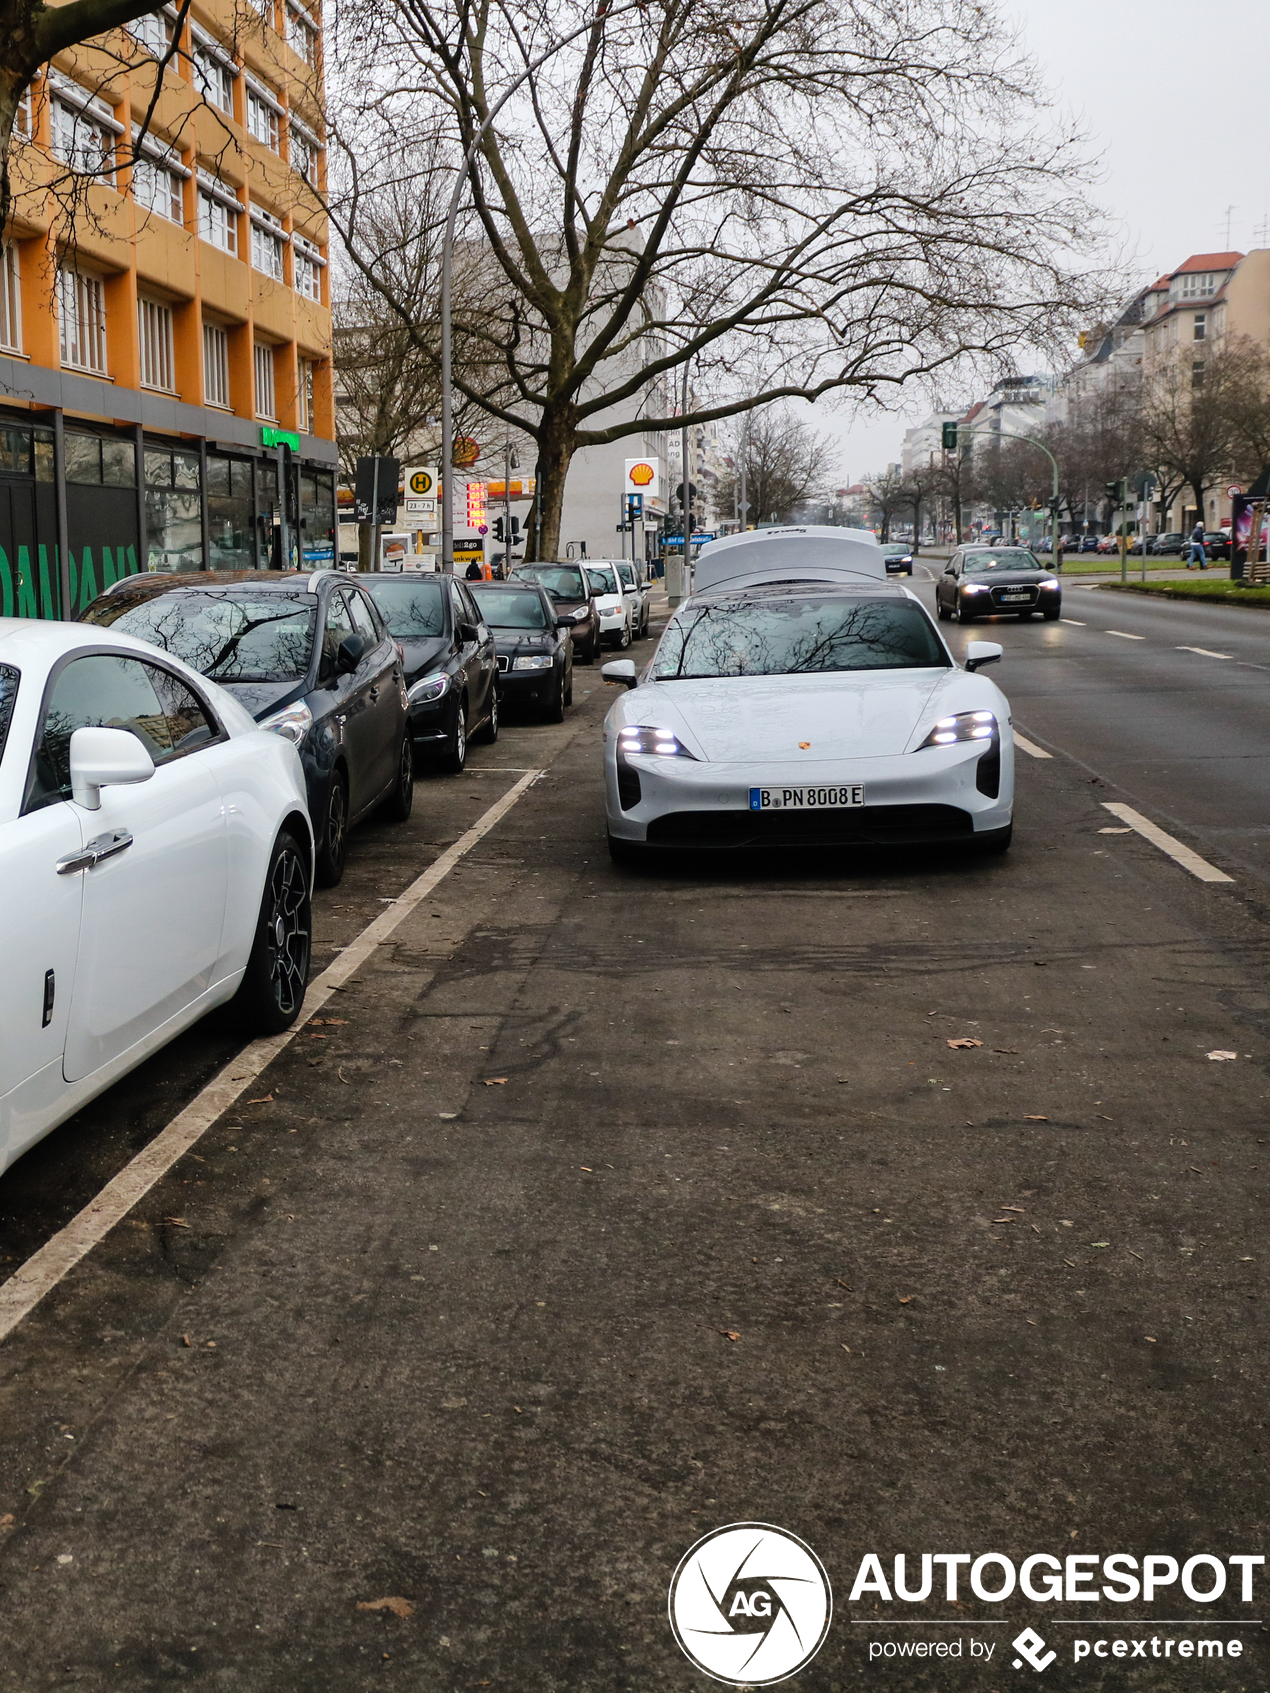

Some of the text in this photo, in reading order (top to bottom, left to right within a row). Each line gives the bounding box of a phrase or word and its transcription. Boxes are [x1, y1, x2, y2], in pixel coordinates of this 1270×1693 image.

[416, 477, 426, 489] H
[761, 790, 771, 807] B
[783, 789, 804, 806] PN
